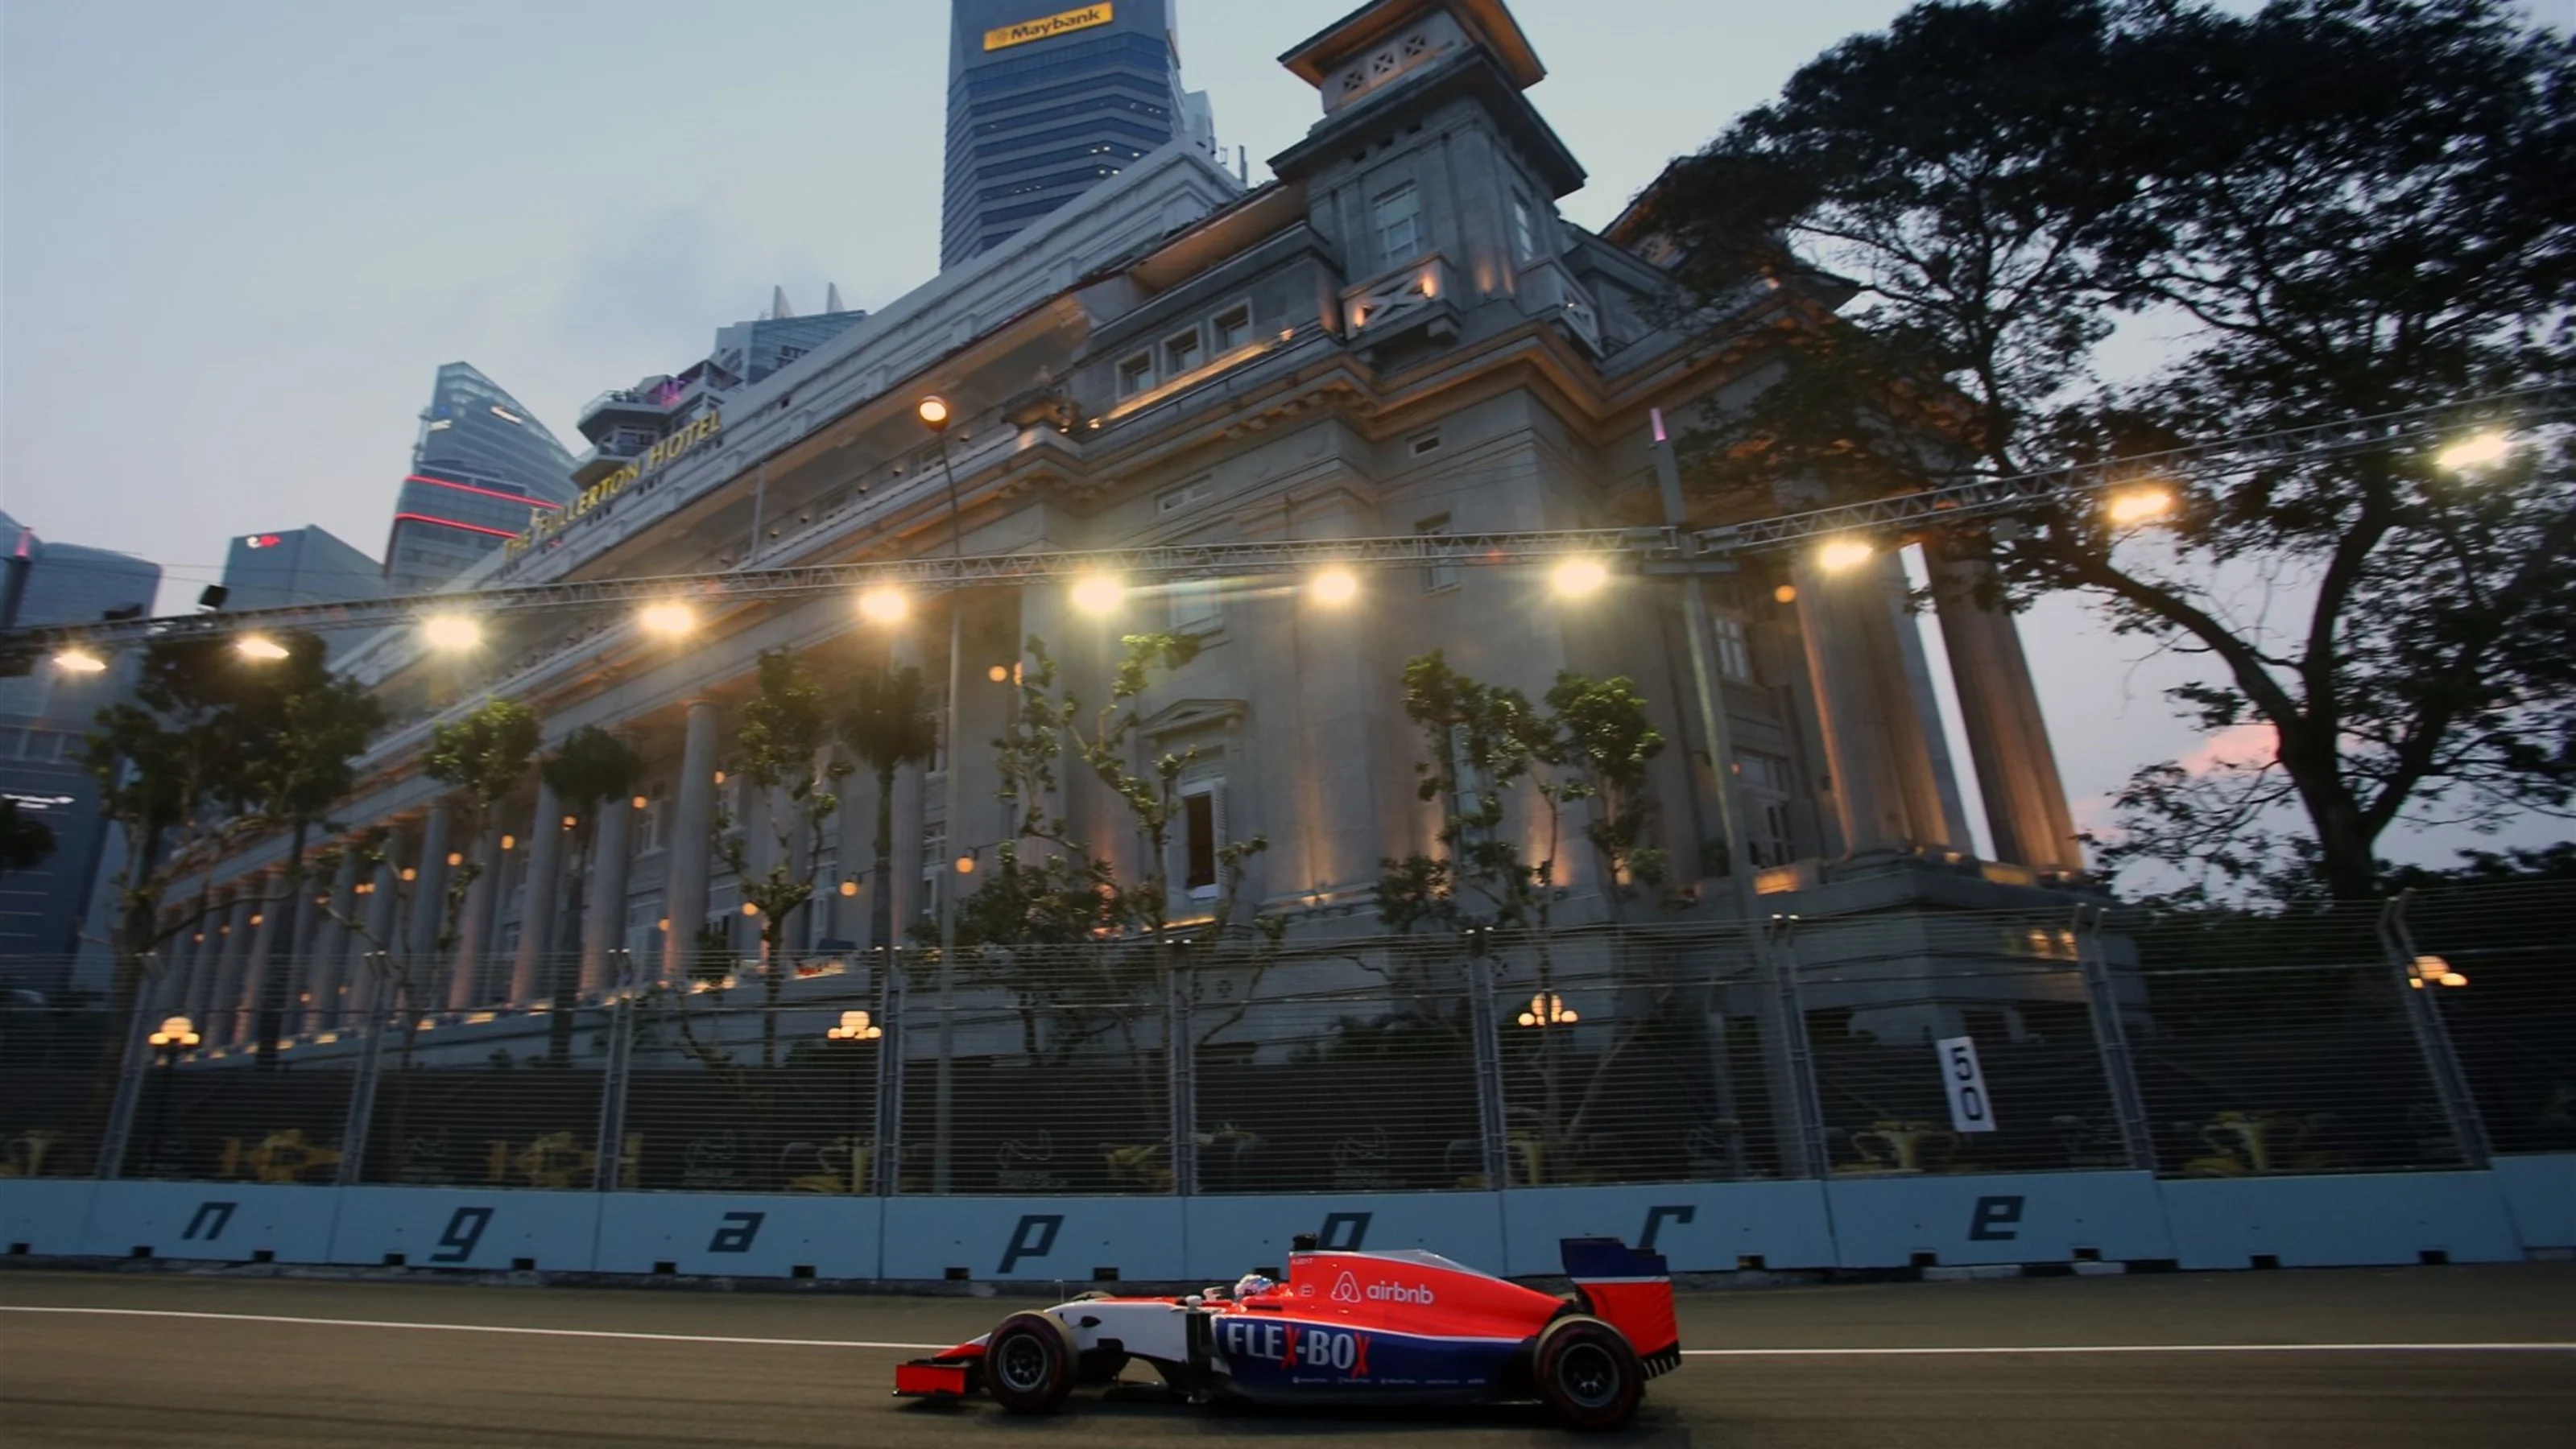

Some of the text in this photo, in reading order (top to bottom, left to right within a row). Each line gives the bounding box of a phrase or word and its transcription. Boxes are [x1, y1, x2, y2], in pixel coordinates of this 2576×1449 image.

[1011, 10, 1100, 39] Maybank
[649, 408, 722, 471] HOTEL
[1951, 1046, 1984, 1121] 50
[1367, 1280, 1435, 1305] airbnb
[1226, 1322, 1371, 1379] FLEX-BOX
